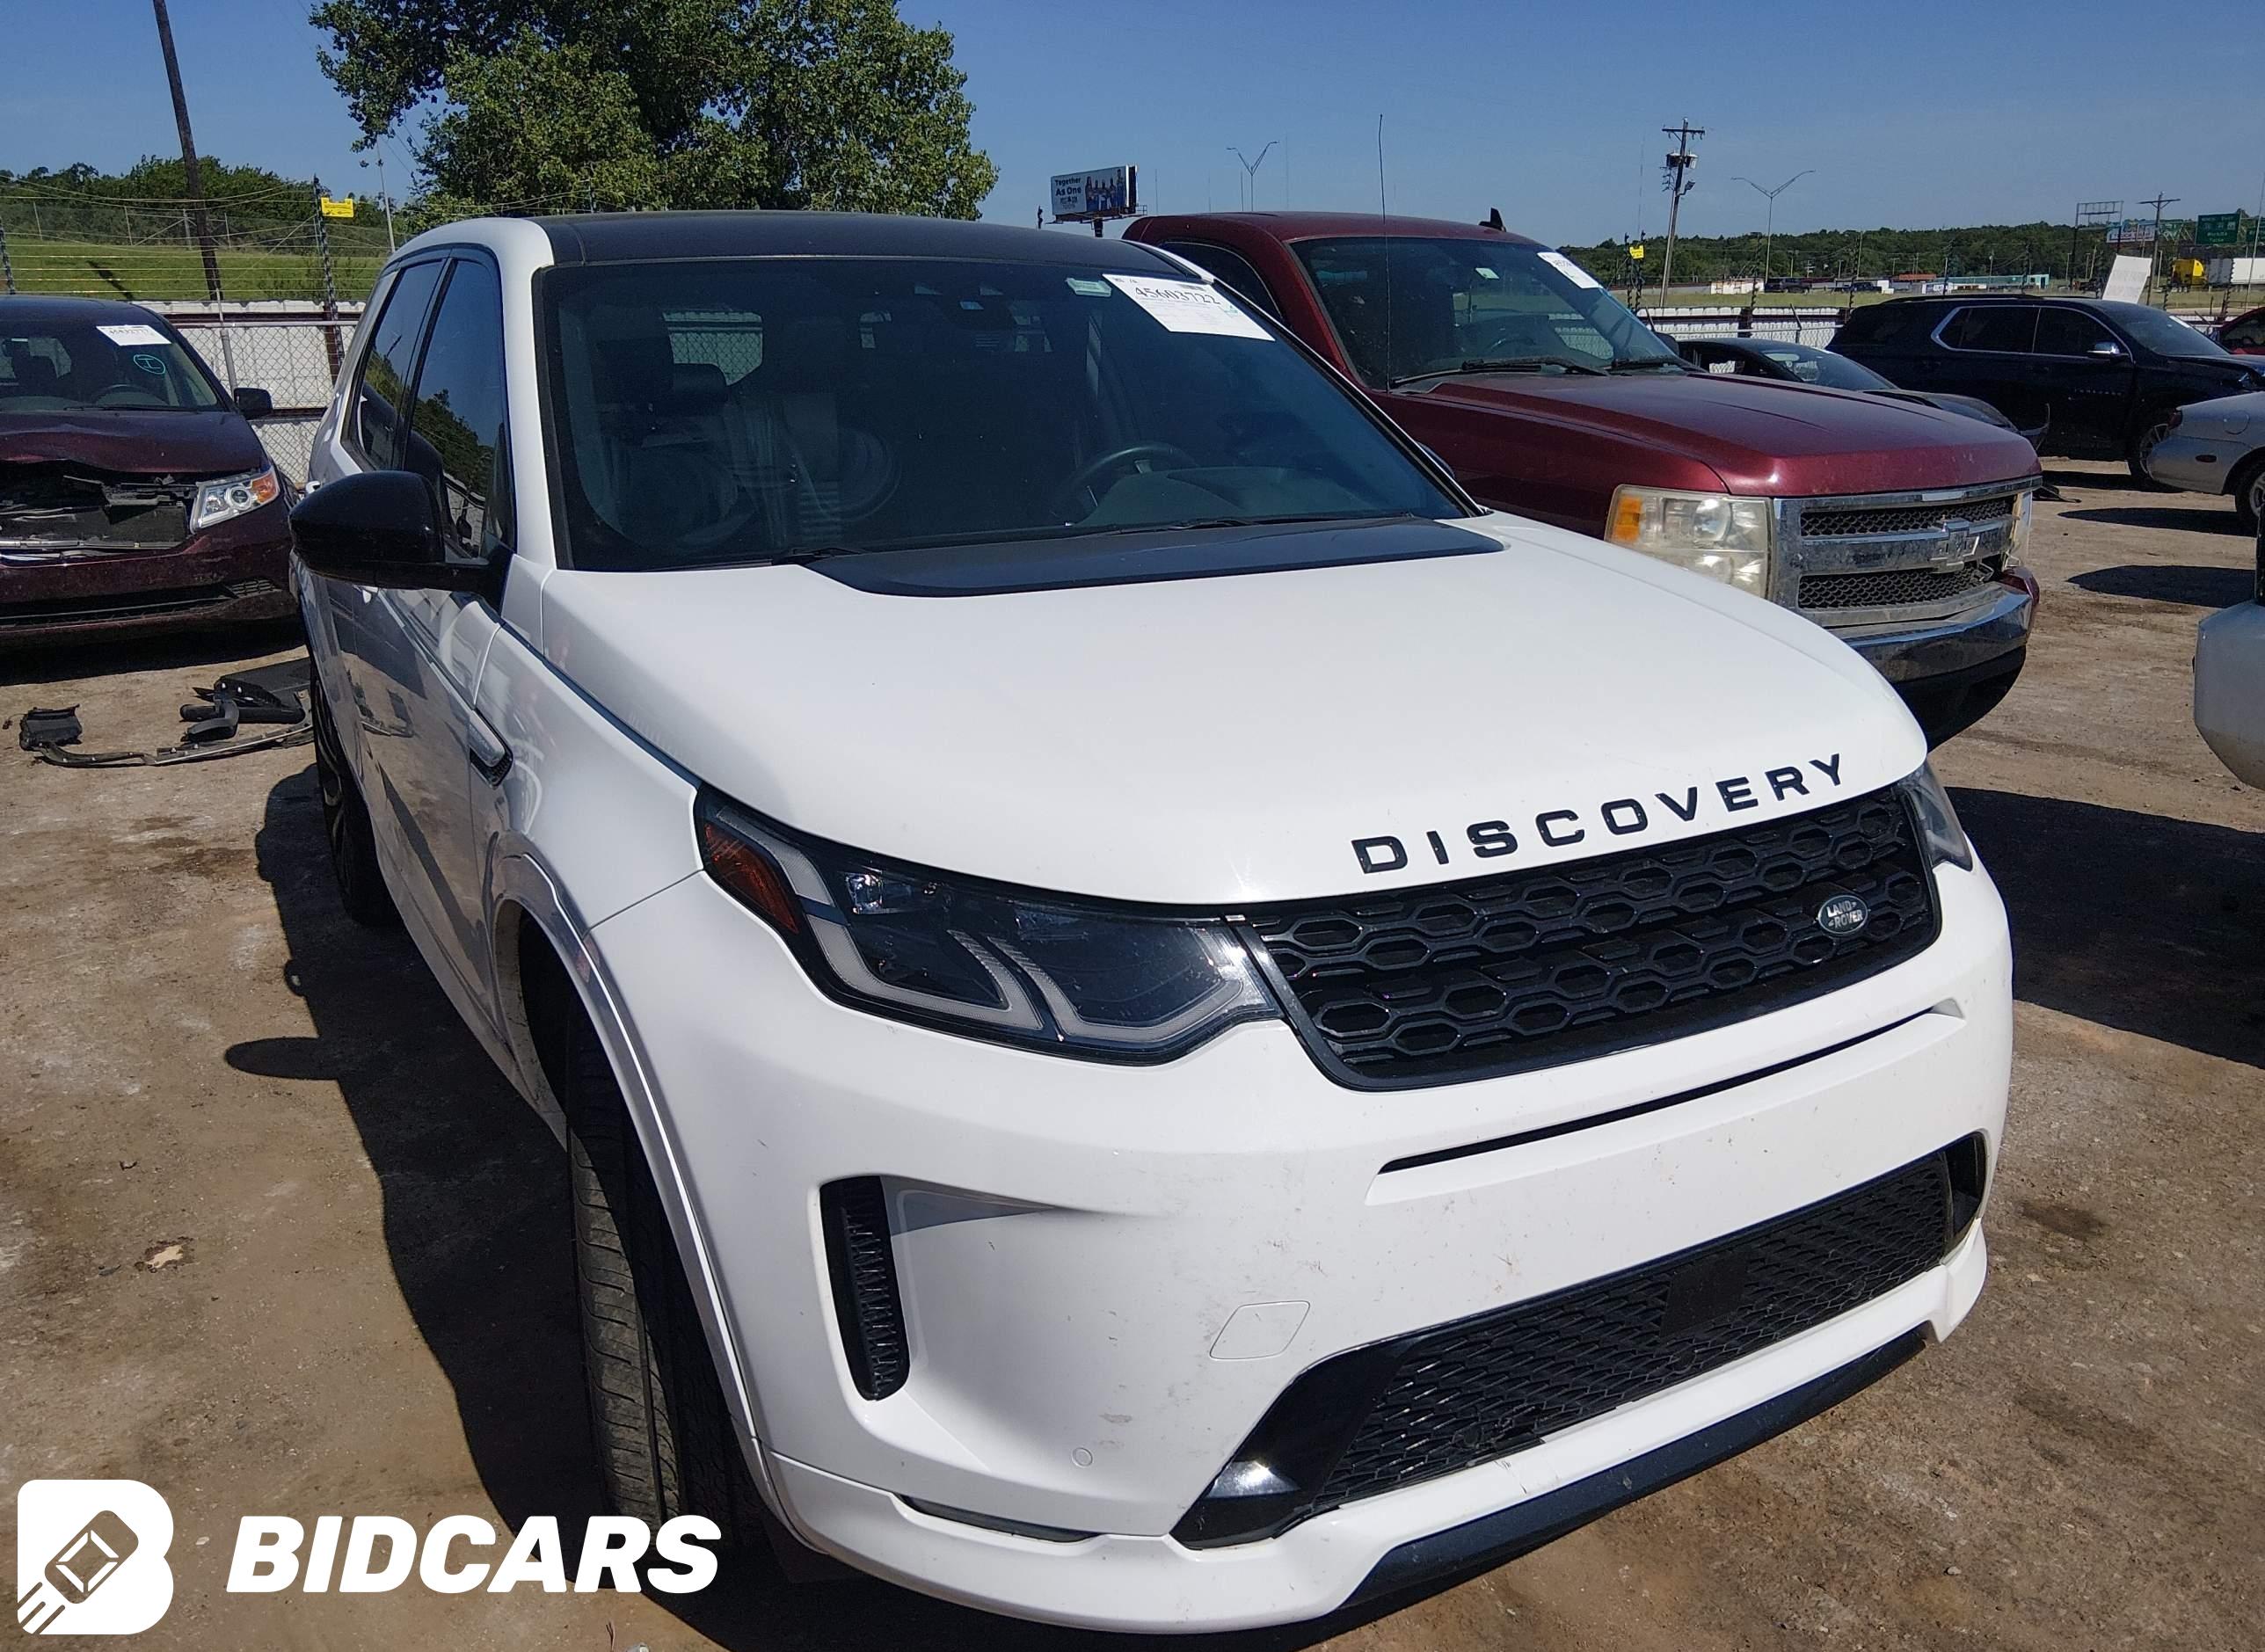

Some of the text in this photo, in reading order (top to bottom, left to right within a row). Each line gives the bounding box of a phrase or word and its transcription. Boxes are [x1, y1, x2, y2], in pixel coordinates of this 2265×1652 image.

[1055, 177, 1081, 186] Together
[1135, 287, 1221, 305] 45603722
[1351, 753, 1843, 875] DISCOVERY
[1826, 900, 1851, 917] LAND
[1834, 909, 1863, 928] ROVER
